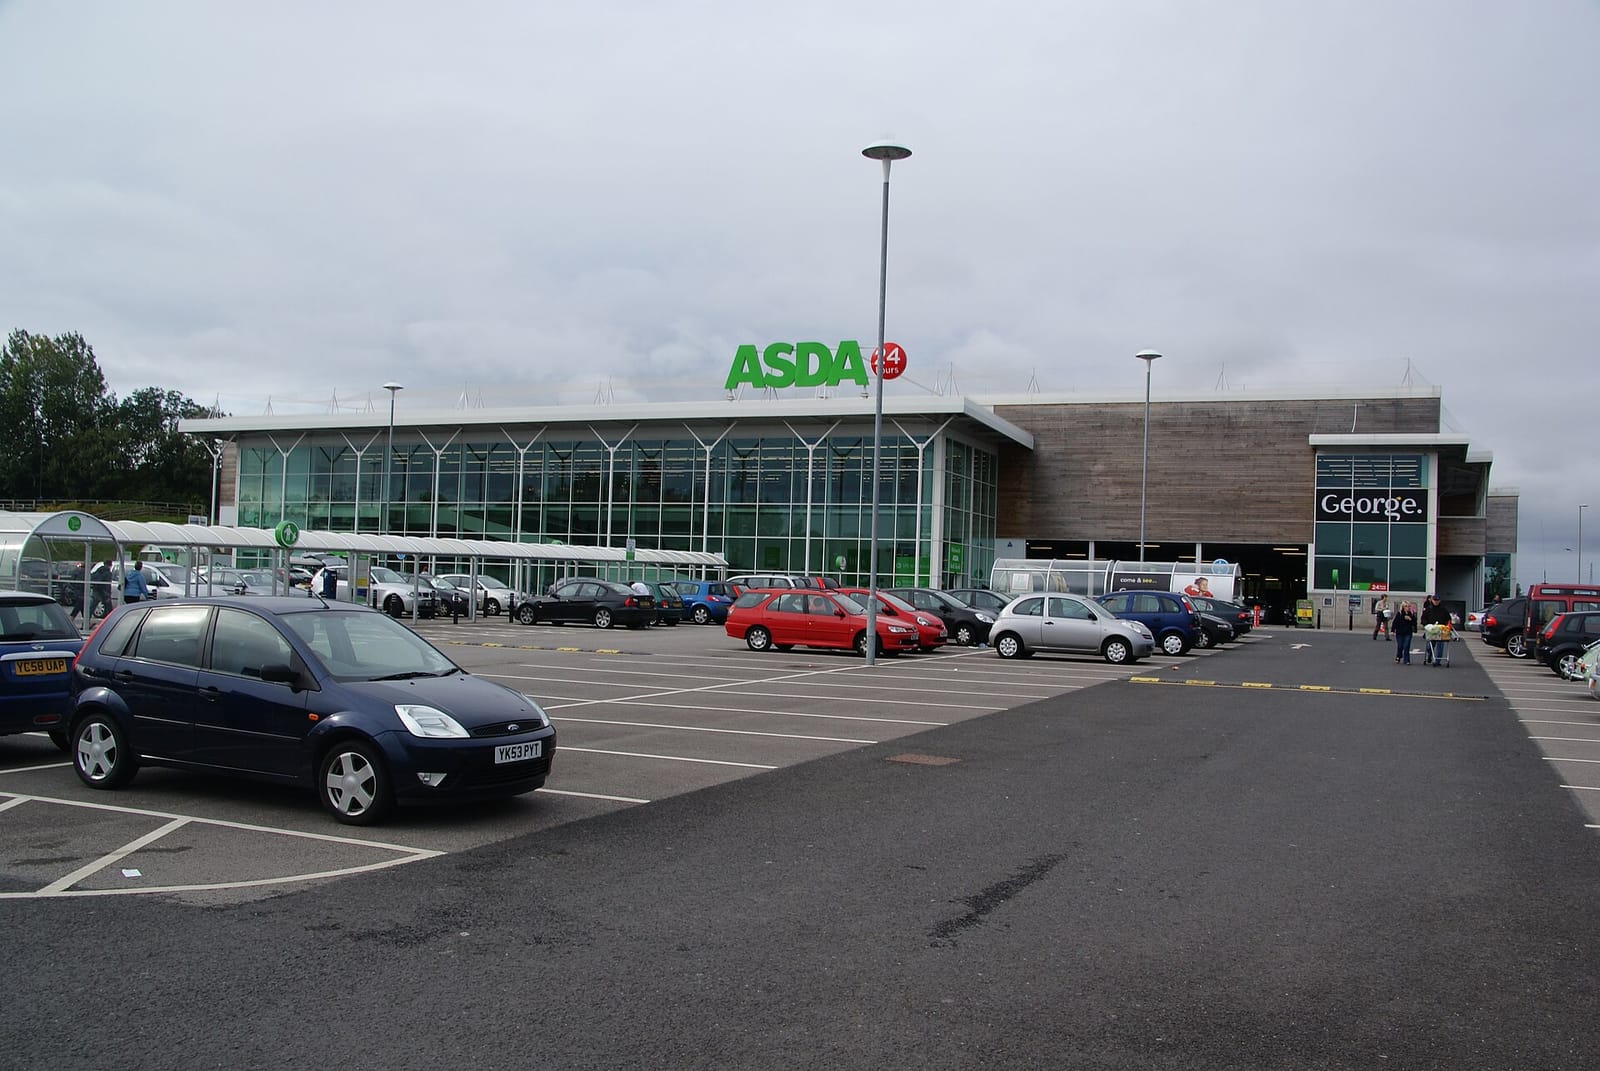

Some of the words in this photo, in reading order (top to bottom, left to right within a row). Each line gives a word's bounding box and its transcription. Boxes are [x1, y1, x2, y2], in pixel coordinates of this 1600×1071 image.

[724, 340, 870, 389] ASDA
[16, 661, 44, 672] YC58
[46, 660, 65, 671] UAP
[499, 746, 522, 760] YK53
[524, 743, 539, 757] PYT
